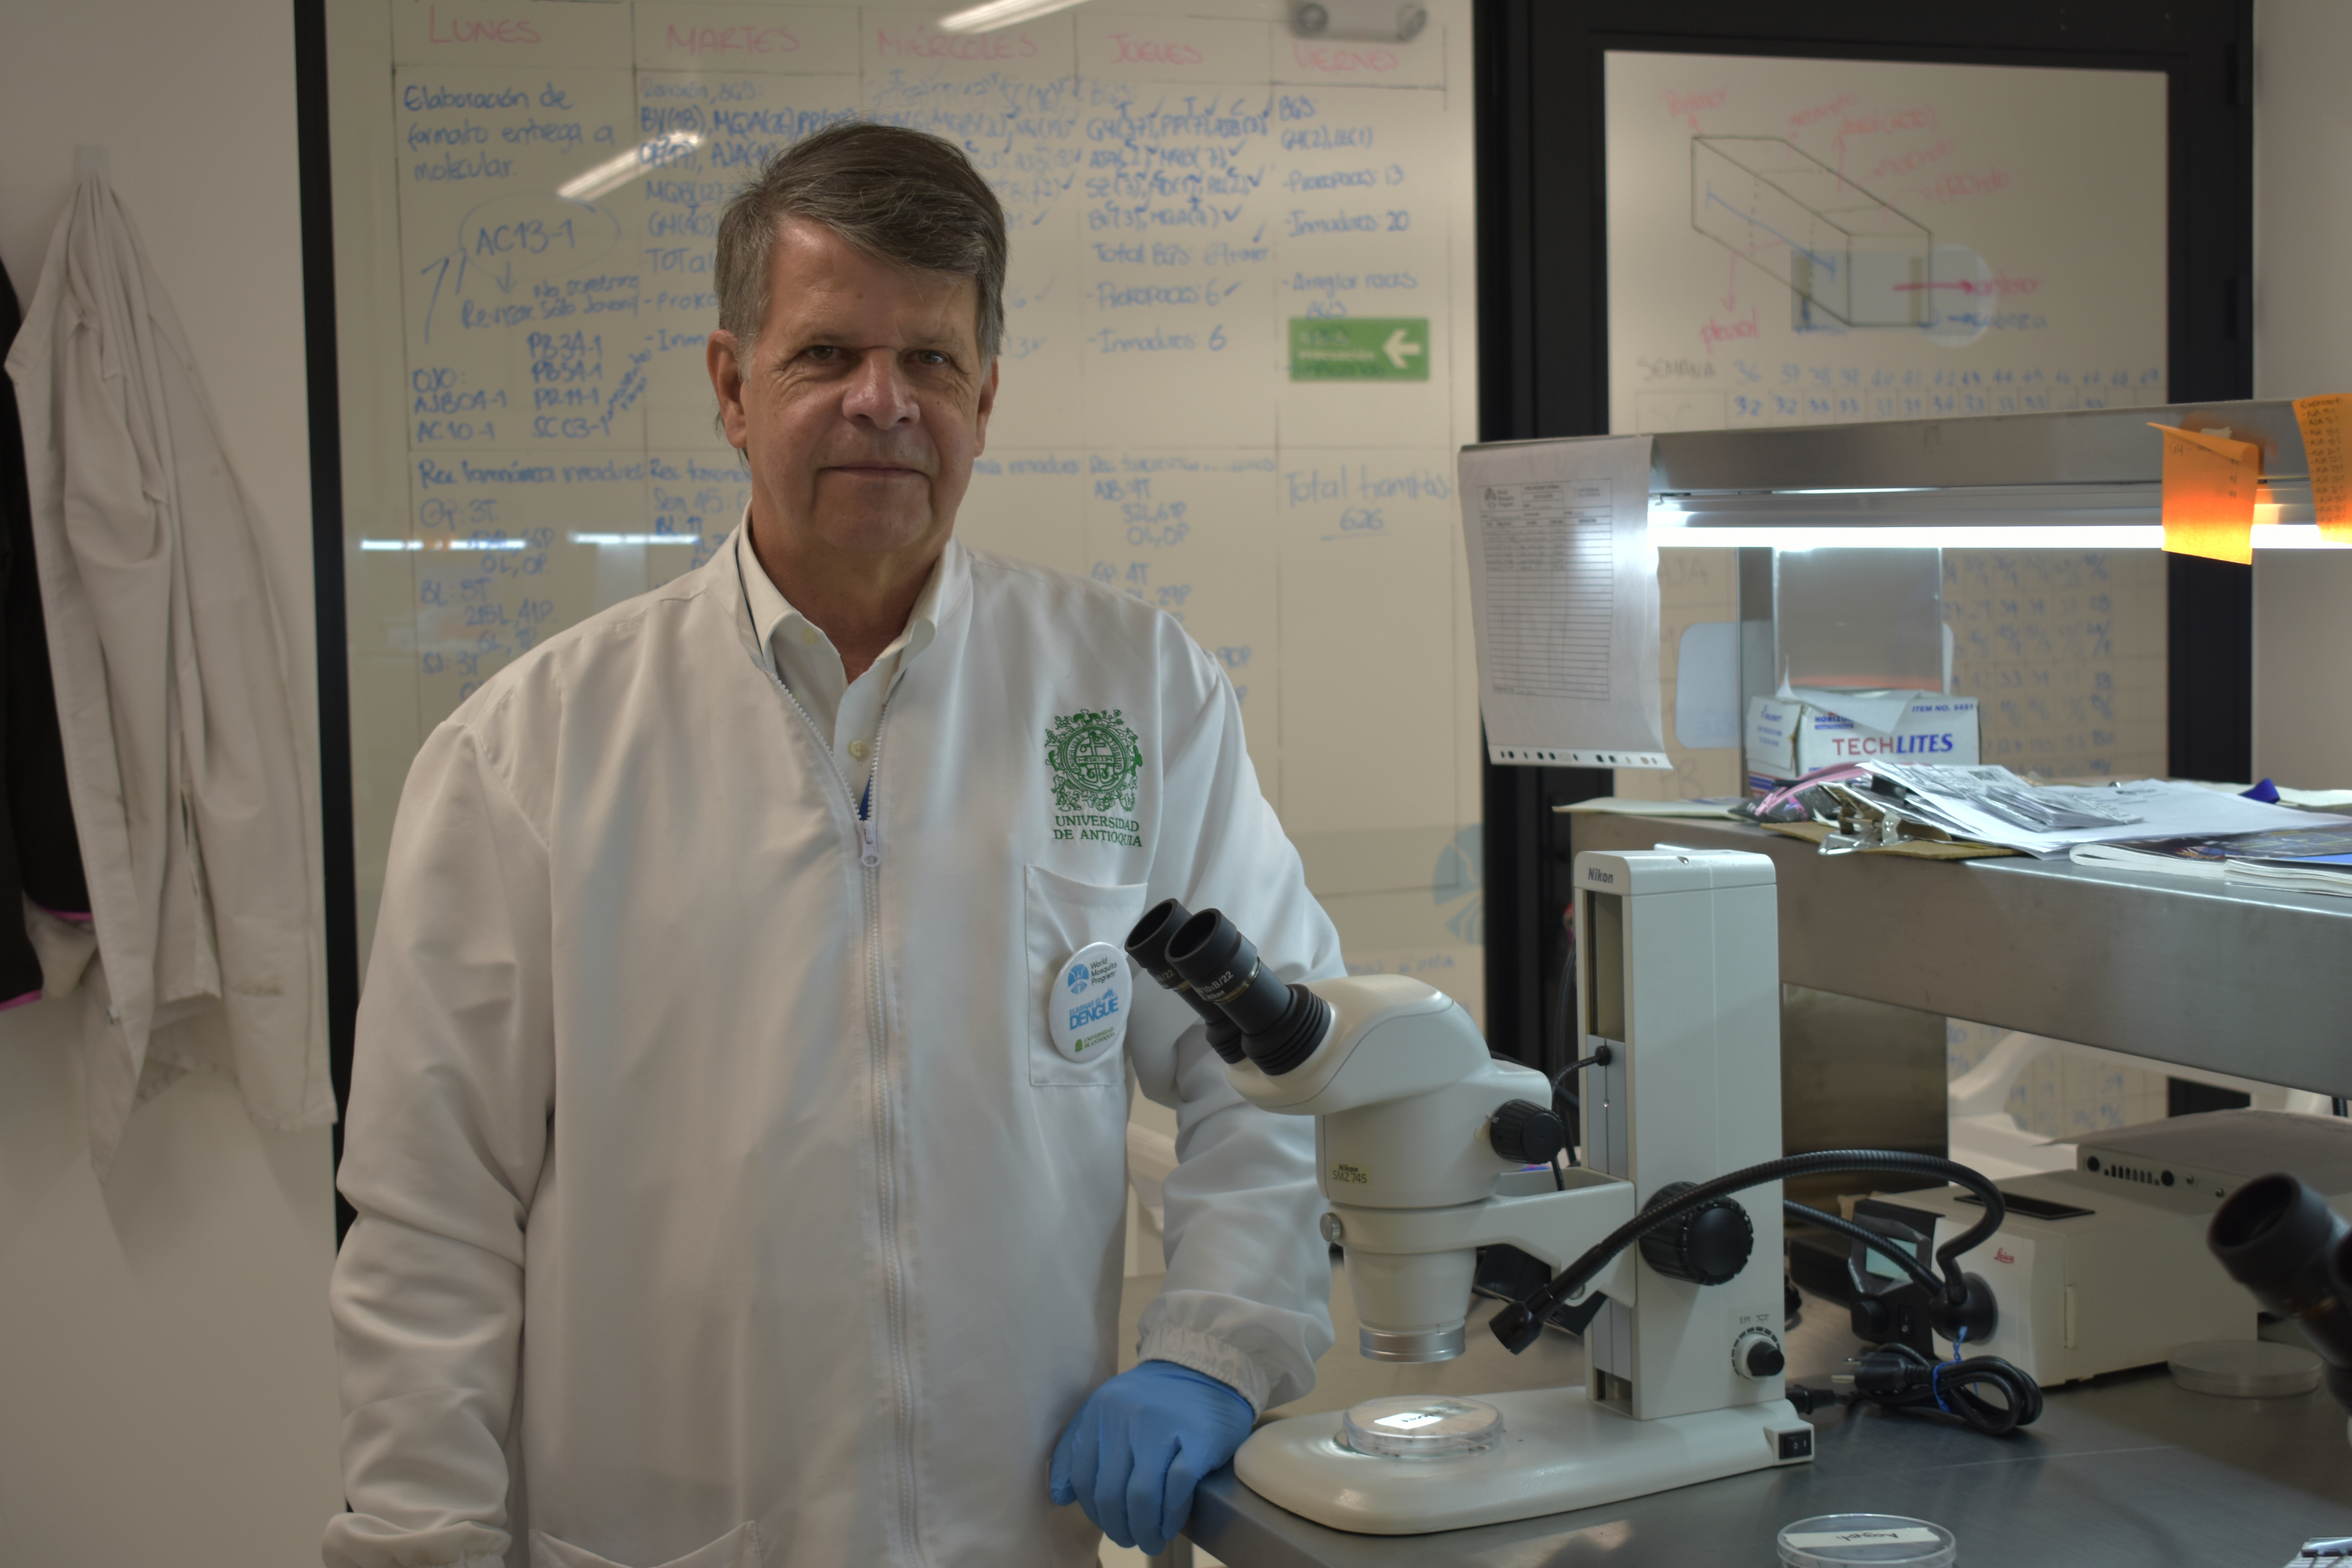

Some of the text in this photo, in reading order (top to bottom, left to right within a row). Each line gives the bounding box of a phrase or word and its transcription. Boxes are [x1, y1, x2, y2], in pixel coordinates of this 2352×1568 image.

[429, 5, 542, 44] LUNES
[667, 24, 802, 56] MARTES
[539, 81, 573, 110] de
[408, 117, 615, 154] formato entrega a
[1207, 323, 1227, 352] 6
[1284, 463, 1347, 509] Total
[1912, 704, 1933, 713] ITEM
[1934, 704, 1951, 712] NO.
[1831, 733, 1953, 756] TECHLITES
[1055, 815, 1140, 832] UNIVERSIDAD
[1053, 829, 1143, 847] DE ANTIOQUIA
[1587, 867, 1614, 884] Nikon
[1090, 956, 1108, 970] World
[1091, 962, 1118, 978] Mosquito
[1206, 990, 1225, 1000] Nikon
[1069, 1000, 1095, 1016] ELIMINAR
[1069, 996, 1120, 1031] DENGUE
[1083, 1026, 1114, 1043] UNIVERSIDAD
[1339, 1163, 1358, 1173] Nikon
[1993, 1247, 2015, 1265] Leica
[1739, 1316, 1751, 1324] EPI
